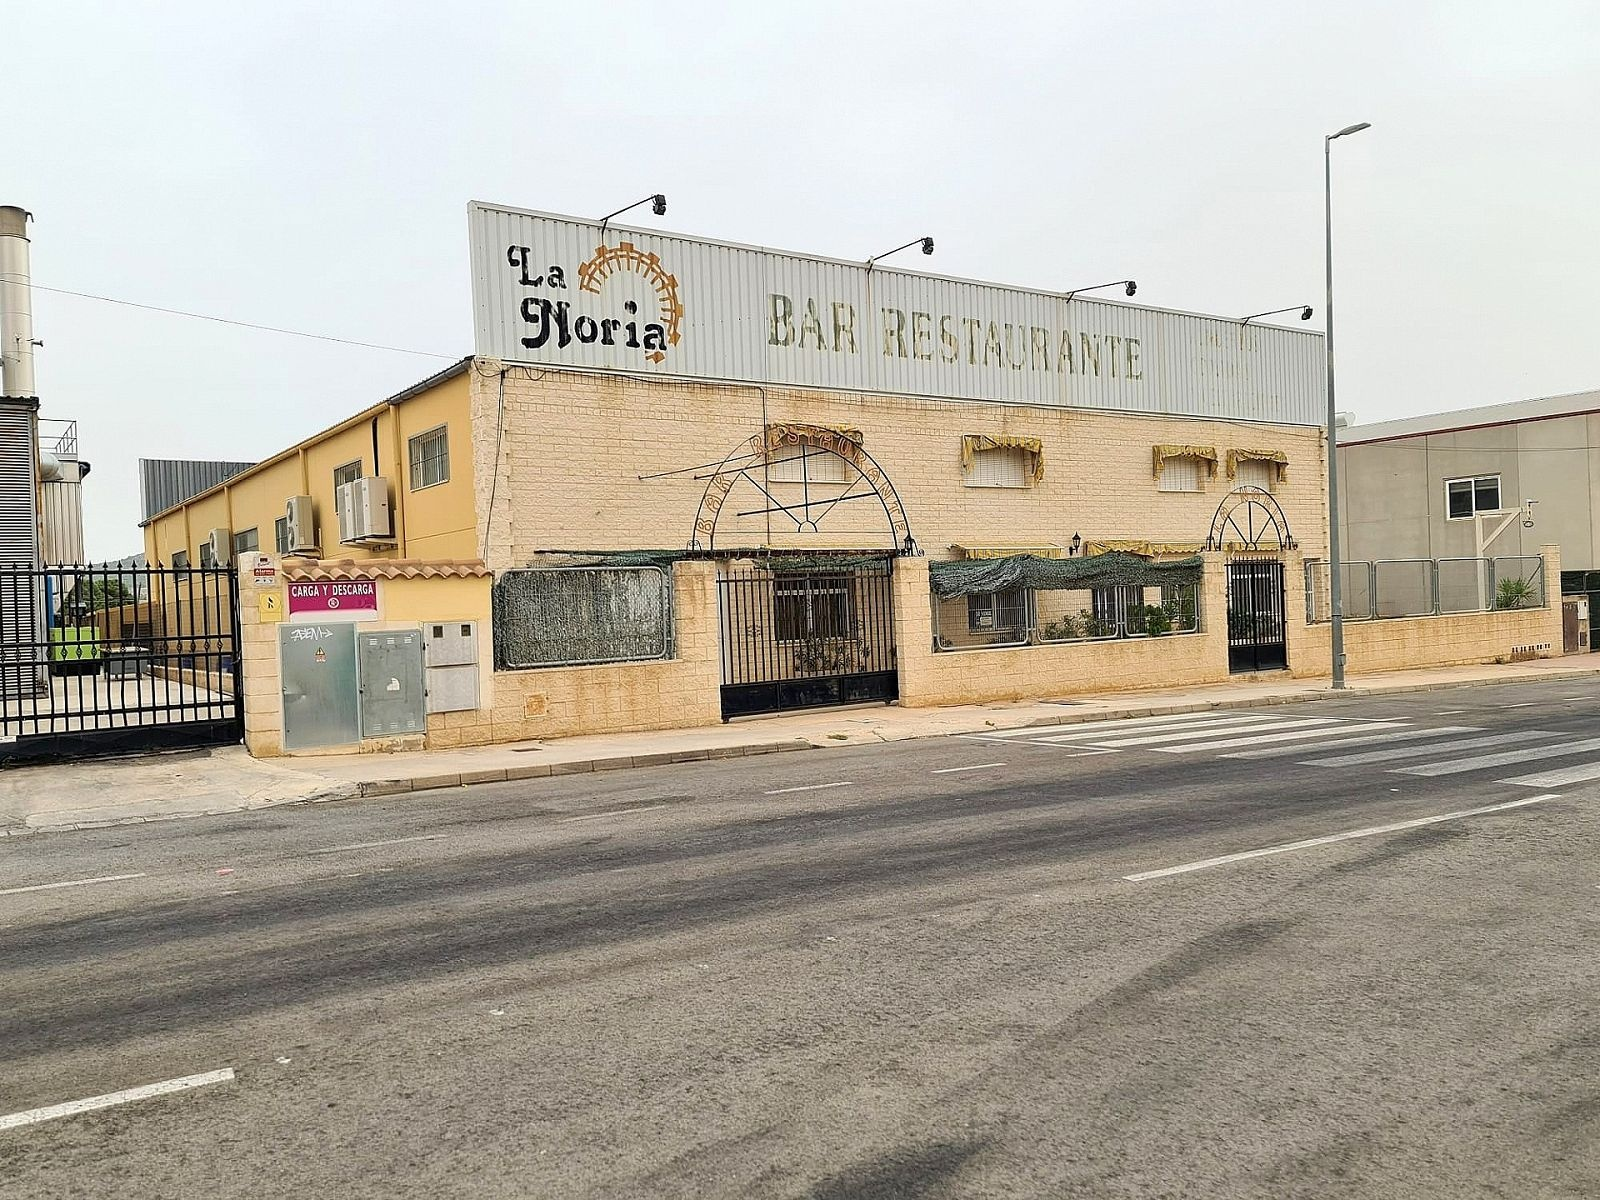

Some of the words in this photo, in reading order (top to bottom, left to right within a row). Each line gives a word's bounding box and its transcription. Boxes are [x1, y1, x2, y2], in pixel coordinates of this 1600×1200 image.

[507, 245, 567, 289] La
[521, 297, 667, 350] Noria
[768, 294, 858, 354] BAR
[881, 307, 1142, 380] RESTAURANTE
[696, 473, 731, 535] BAR
[750, 427, 906, 533] RESTAURANTE
[291, 585, 319, 597] CARGA
[322, 585, 328, 596] Y
[332, 583, 374, 596] DESCARGA
